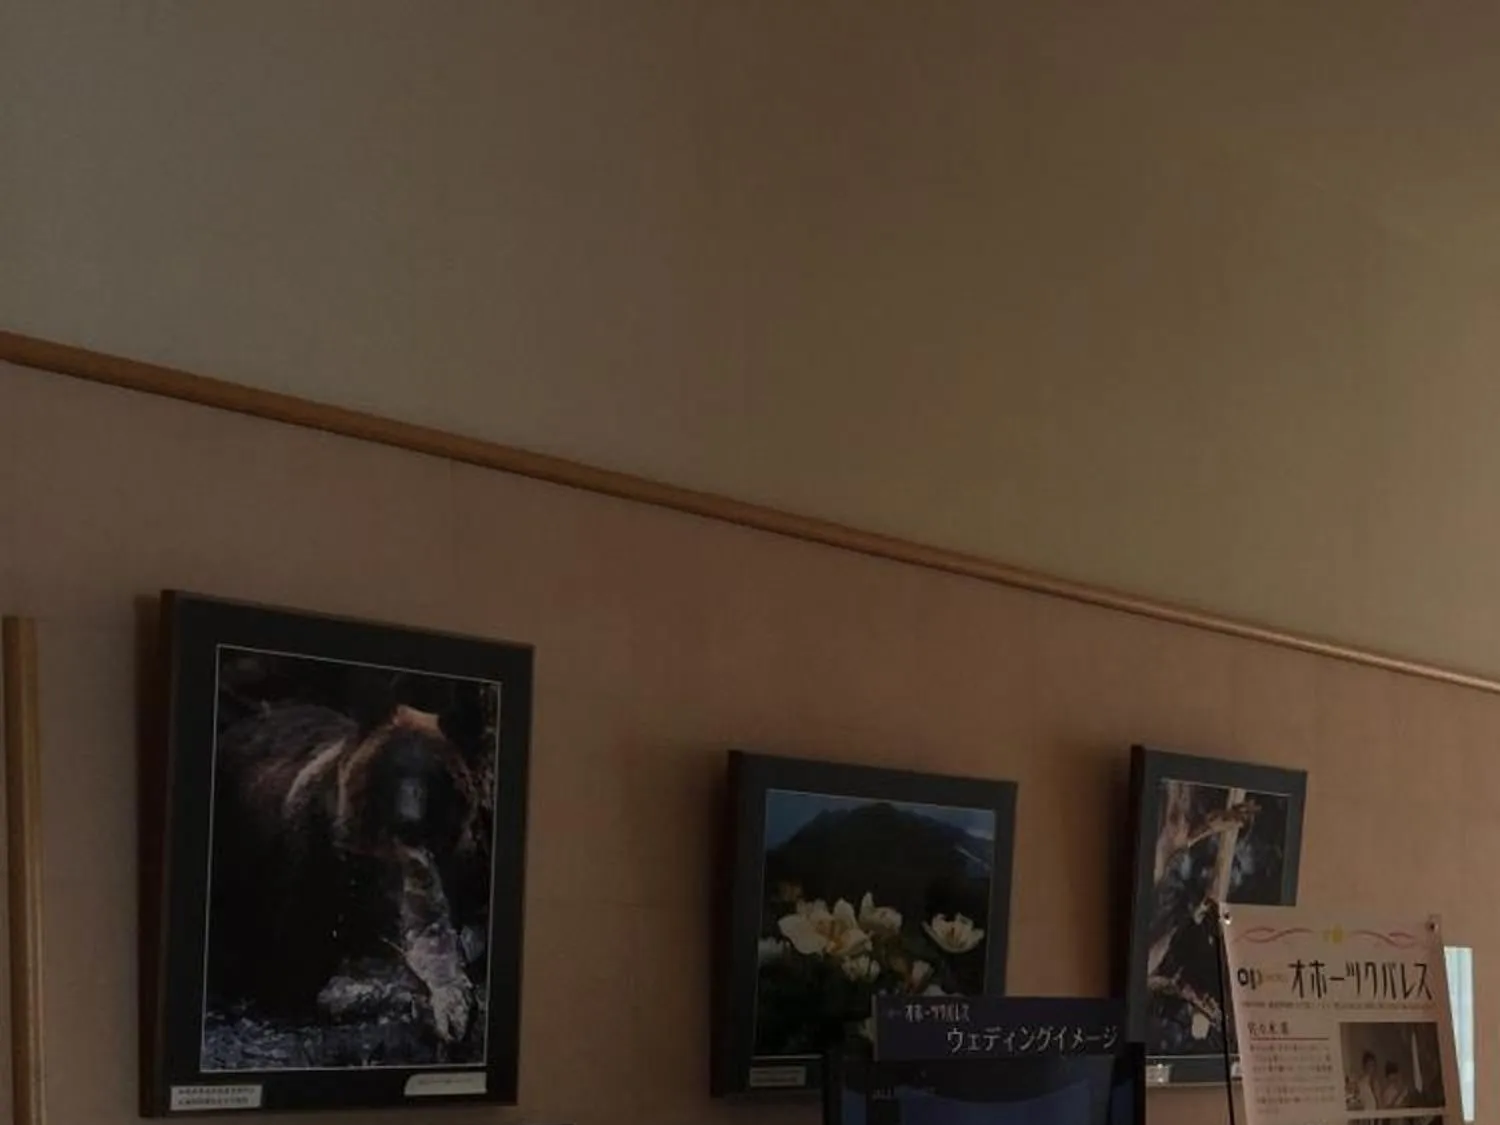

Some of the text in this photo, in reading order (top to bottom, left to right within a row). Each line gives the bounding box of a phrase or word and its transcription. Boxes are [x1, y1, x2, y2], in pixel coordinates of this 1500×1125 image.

[946, 1025, 1119, 1053] ウェディングイメージ
